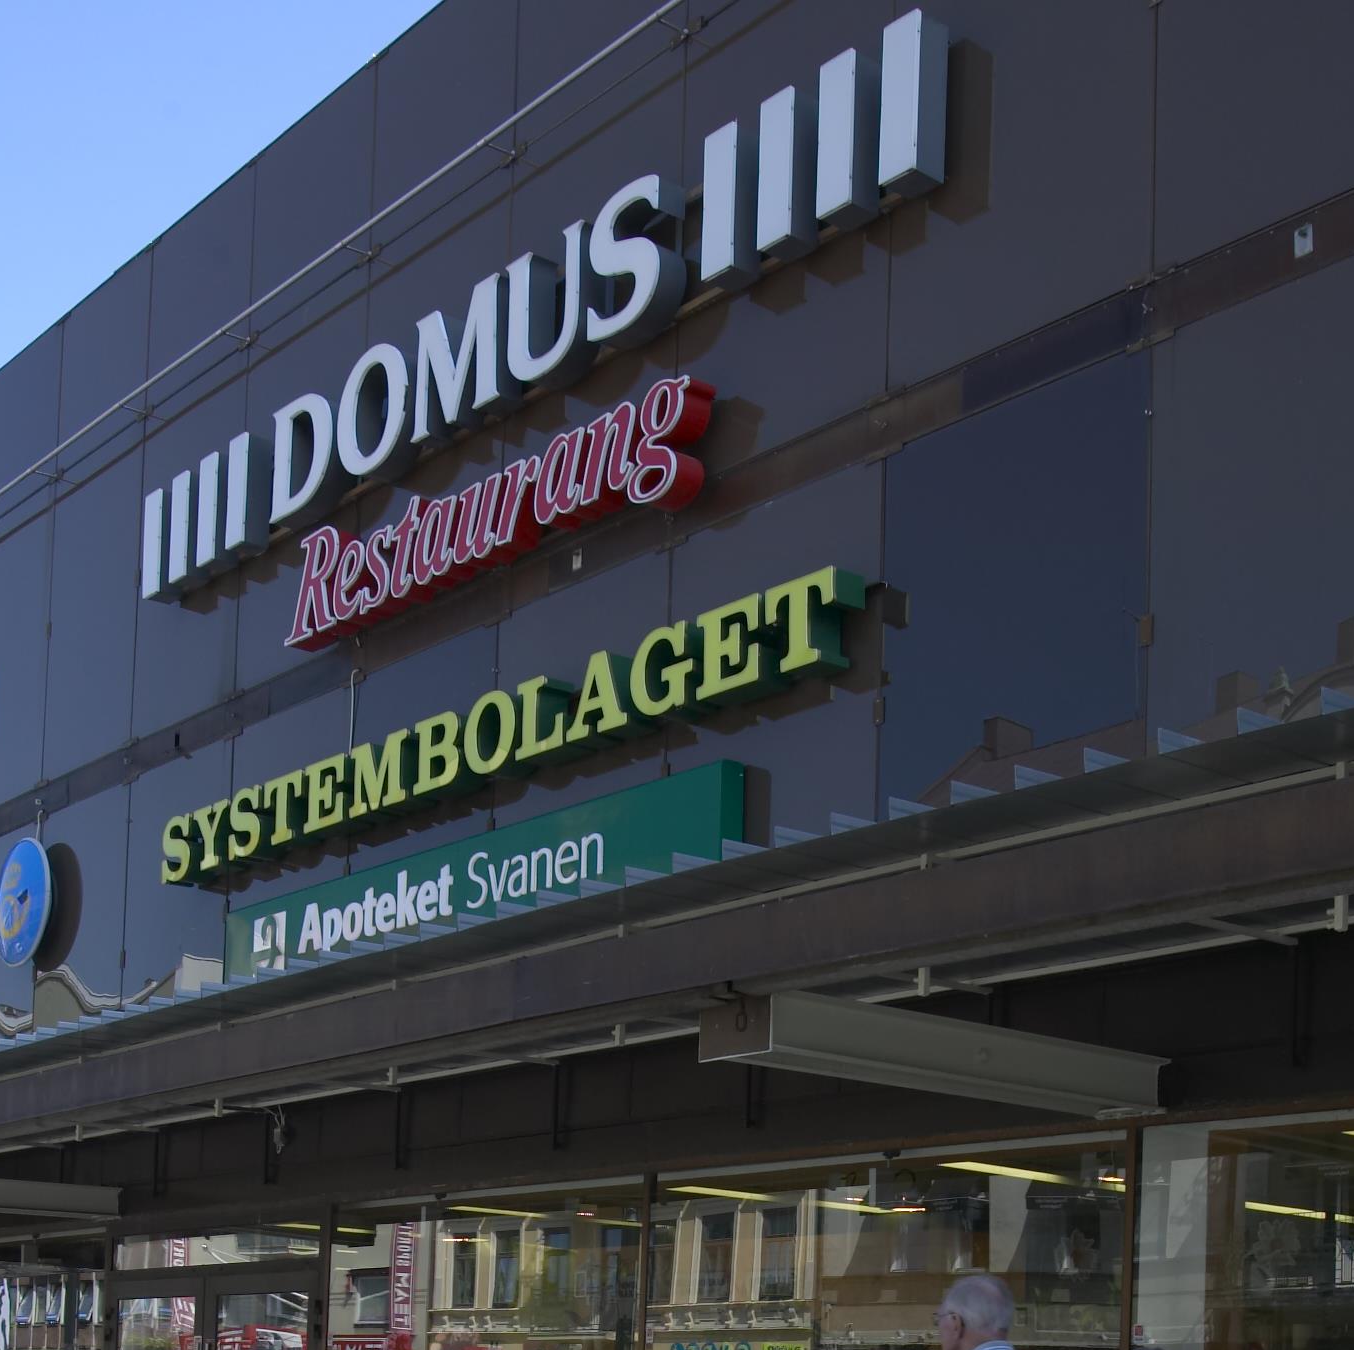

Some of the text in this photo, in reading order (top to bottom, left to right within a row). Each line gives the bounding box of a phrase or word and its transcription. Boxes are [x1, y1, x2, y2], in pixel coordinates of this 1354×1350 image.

[269, 173, 661, 525] DOMUS
[283, 374, 693, 647] Restaurang
[160, 564, 837, 886] SYSTEMBOLAGET
[297, 830, 604, 954] Apoteket Svanen
